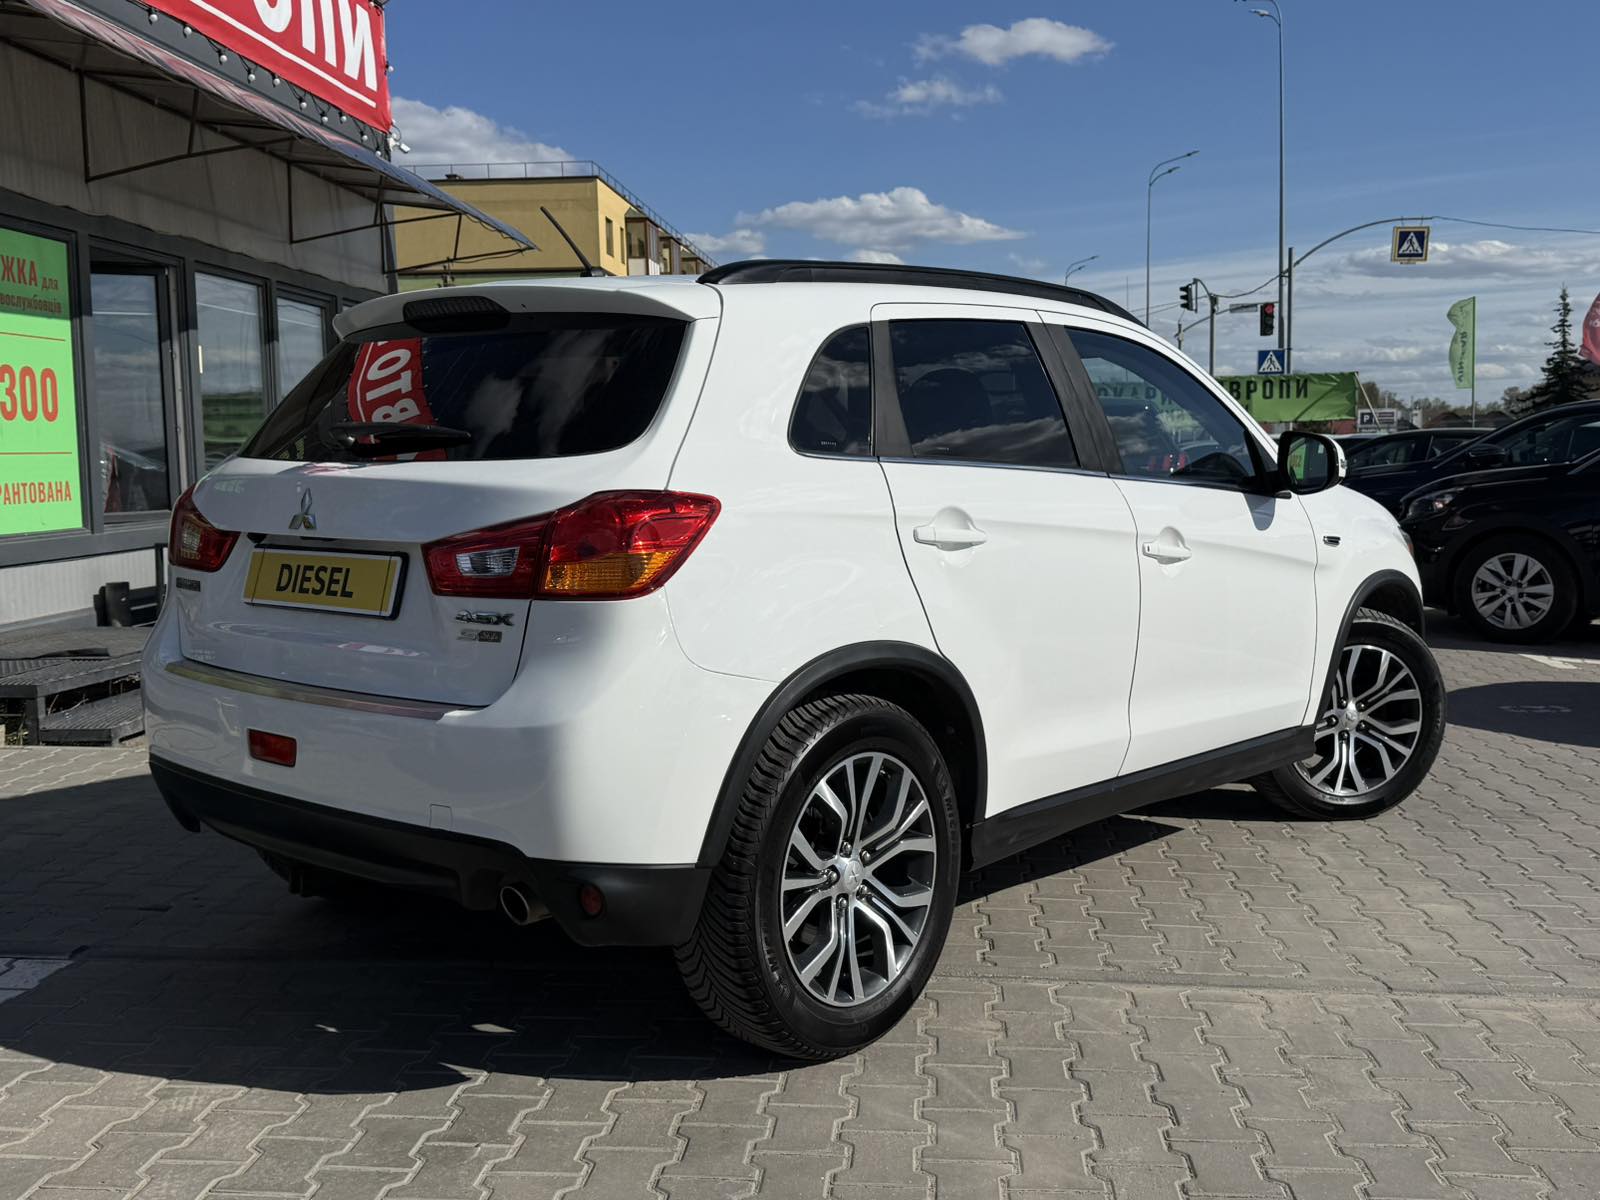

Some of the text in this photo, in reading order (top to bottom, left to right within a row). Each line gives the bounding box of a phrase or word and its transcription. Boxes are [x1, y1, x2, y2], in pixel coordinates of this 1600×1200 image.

[0, 364, 59, 422] 300
[1218, 378, 1309, 401] ВРОПИ
[276, 563, 354, 598] DIESEL
